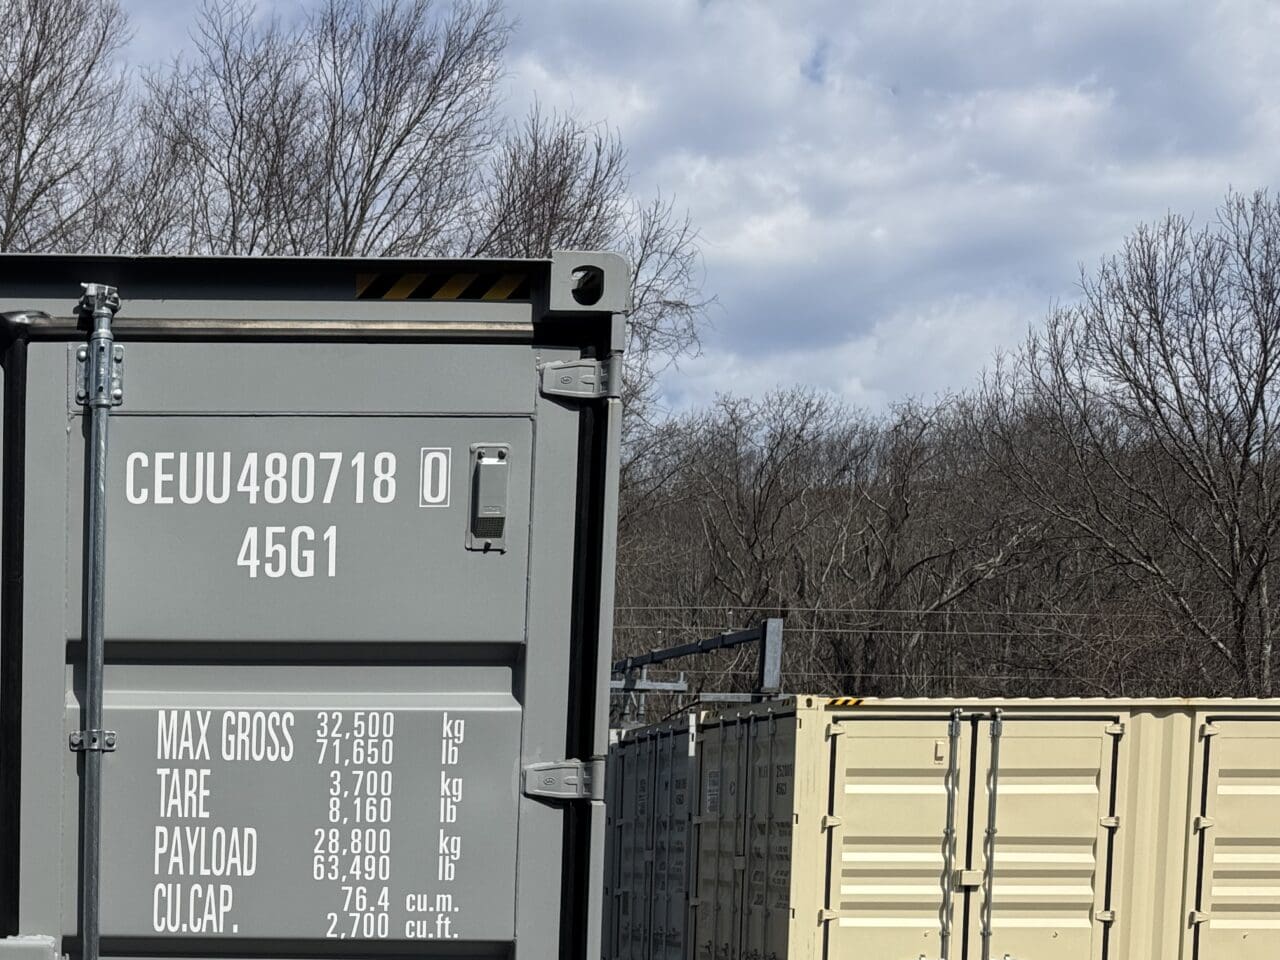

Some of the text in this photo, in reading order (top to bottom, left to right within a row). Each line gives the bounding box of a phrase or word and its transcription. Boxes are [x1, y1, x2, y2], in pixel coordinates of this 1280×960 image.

[125, 451, 448, 505] CEUU480718 0
[236, 525, 338, 579] 45G1
[157, 709, 465, 761] MAX GROSS 32,500 kg
[316, 739, 459, 767] 71,650 lb
[156, 768, 463, 818] TARE 3,700 kg
[328, 797, 457, 824] 8,160 lb
[154, 826, 461, 876] PAYLOAD 28,800 kg
[313, 855, 455, 882] 63,490 lb
[153, 883, 459, 933] CU.CAP. 76.4 cu.m.
[326, 913, 459, 940] 2,700 cu.ft.
